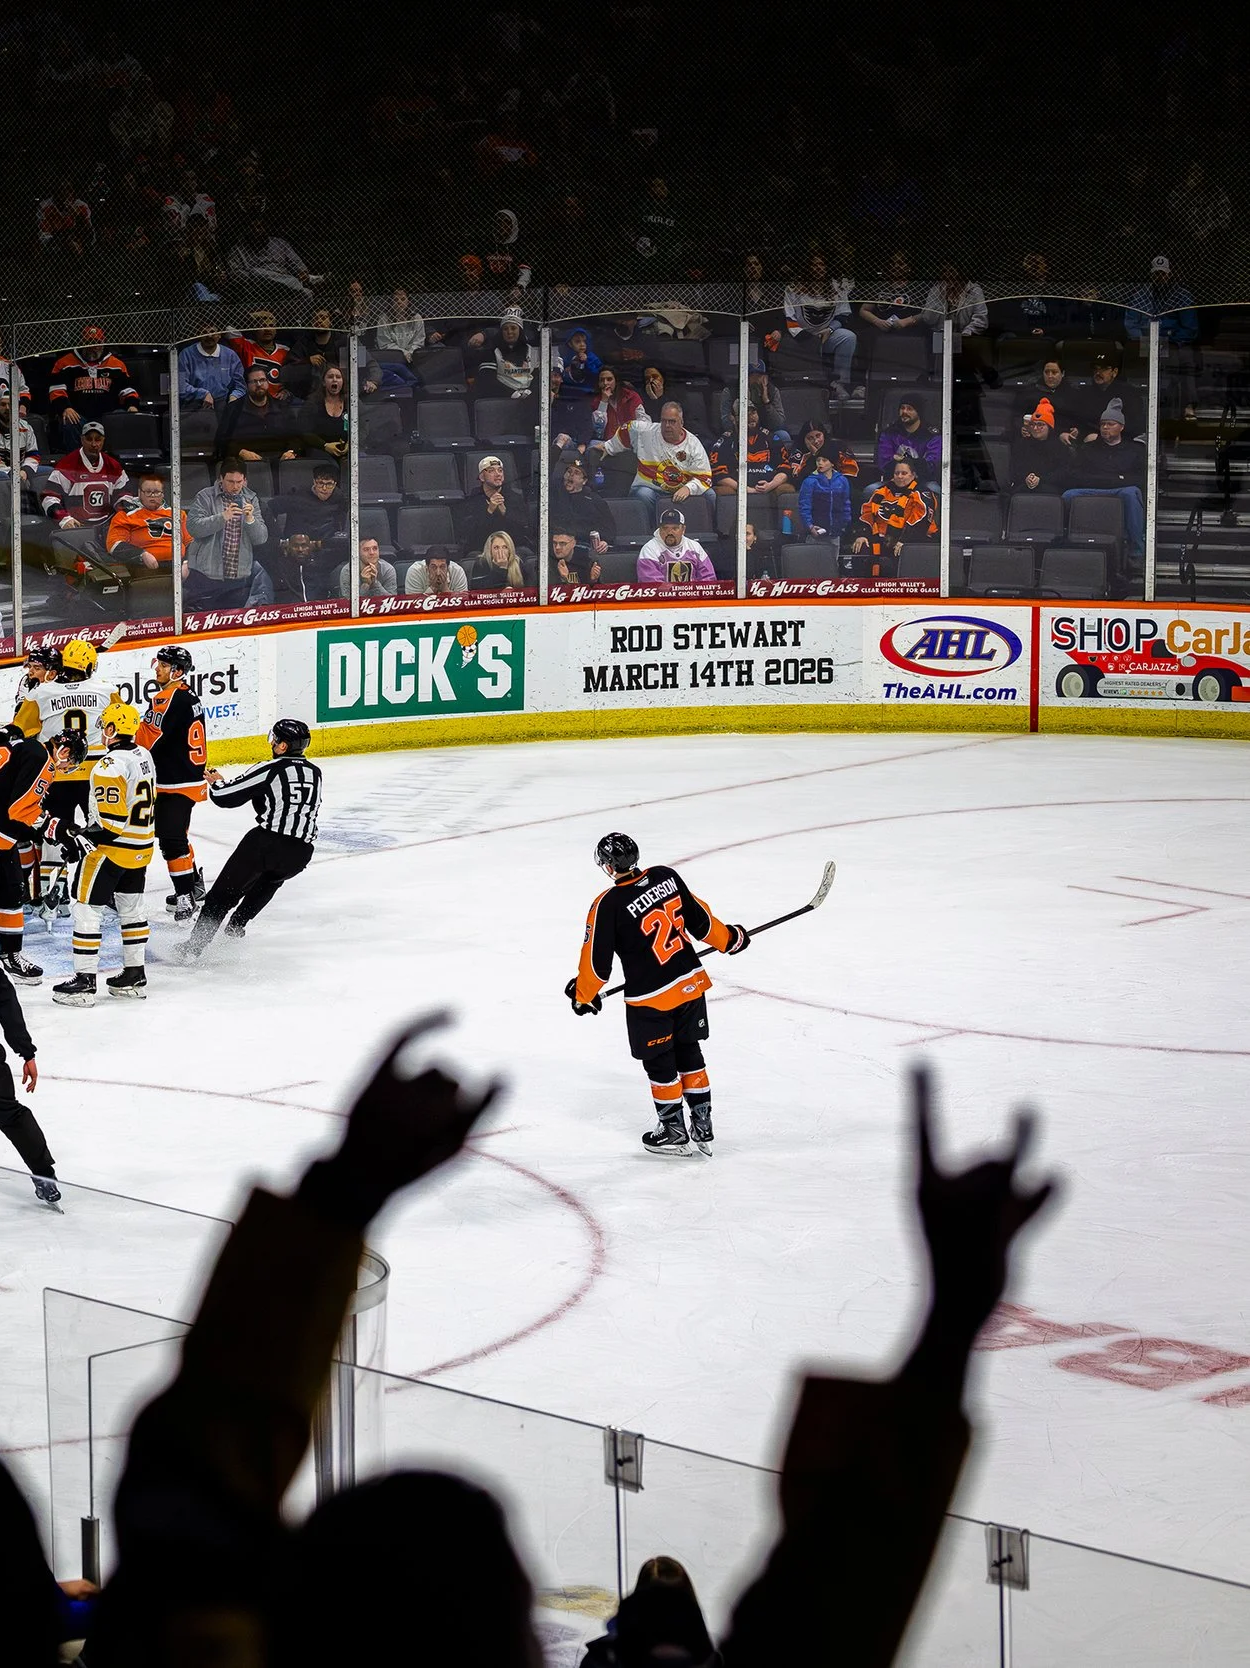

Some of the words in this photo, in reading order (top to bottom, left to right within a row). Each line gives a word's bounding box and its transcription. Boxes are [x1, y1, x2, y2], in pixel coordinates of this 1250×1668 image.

[89, 490, 104, 506] 67
[615, 585, 657, 600] GLASS
[817, 580, 859, 596] GLASS
[422, 594, 462, 611] GLASS
[243, 609, 280, 625] GLASS
[610, 624, 663, 654] ROD
[673, 619, 805, 651] STEWART
[1053, 617, 1158, 652] SHOP
[904, 628, 997, 662] AHL
[328, 630, 513, 709] DICK'S
[583, 661, 679, 693] MARCH
[689, 659, 754, 689] 14TH
[764, 657, 834, 686] 2026
[1129, 662, 1171, 671] CARJAZZ
[883, 683, 1017, 701] TheAHL.com
[52, 694, 98, 711] McDONOUGH
[94, 786, 120, 804] 26
[290, 782, 314, 805] 57
[626, 877, 679, 919] PEDERSON
[641, 895, 693, 966] 25
[646, 1034, 674, 1047] CCM
